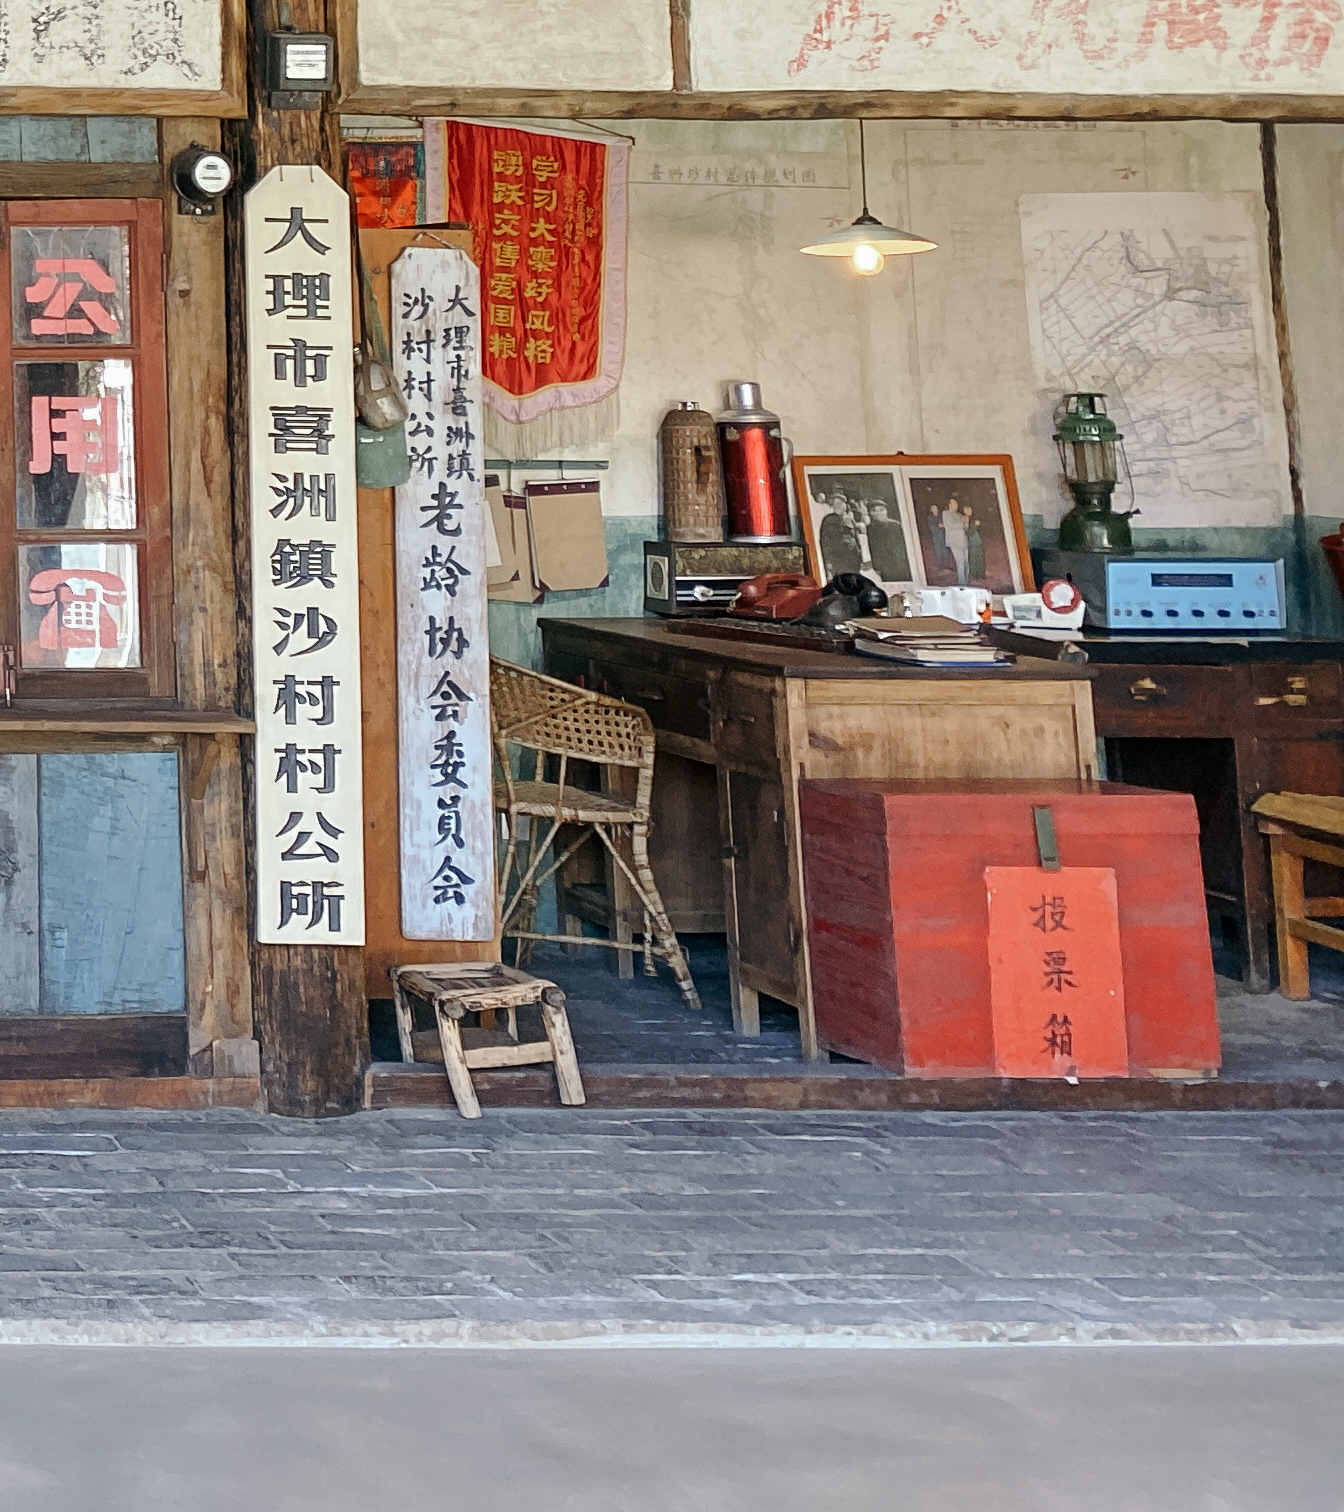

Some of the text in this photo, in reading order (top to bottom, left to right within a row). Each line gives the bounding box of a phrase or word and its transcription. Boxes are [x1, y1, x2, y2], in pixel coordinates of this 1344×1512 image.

[488, 150, 526, 359] 踊跃交售爱国粮
[524, 155, 561, 364] 学习大寨好风格
[25, 257, 120, 475] 公用
[402, 288, 438, 480] 沙村村公所
[264, 205, 346, 936] 大理市喜洲鎮沙村村公所
[1029, 895, 1077, 1057] 投票箱
